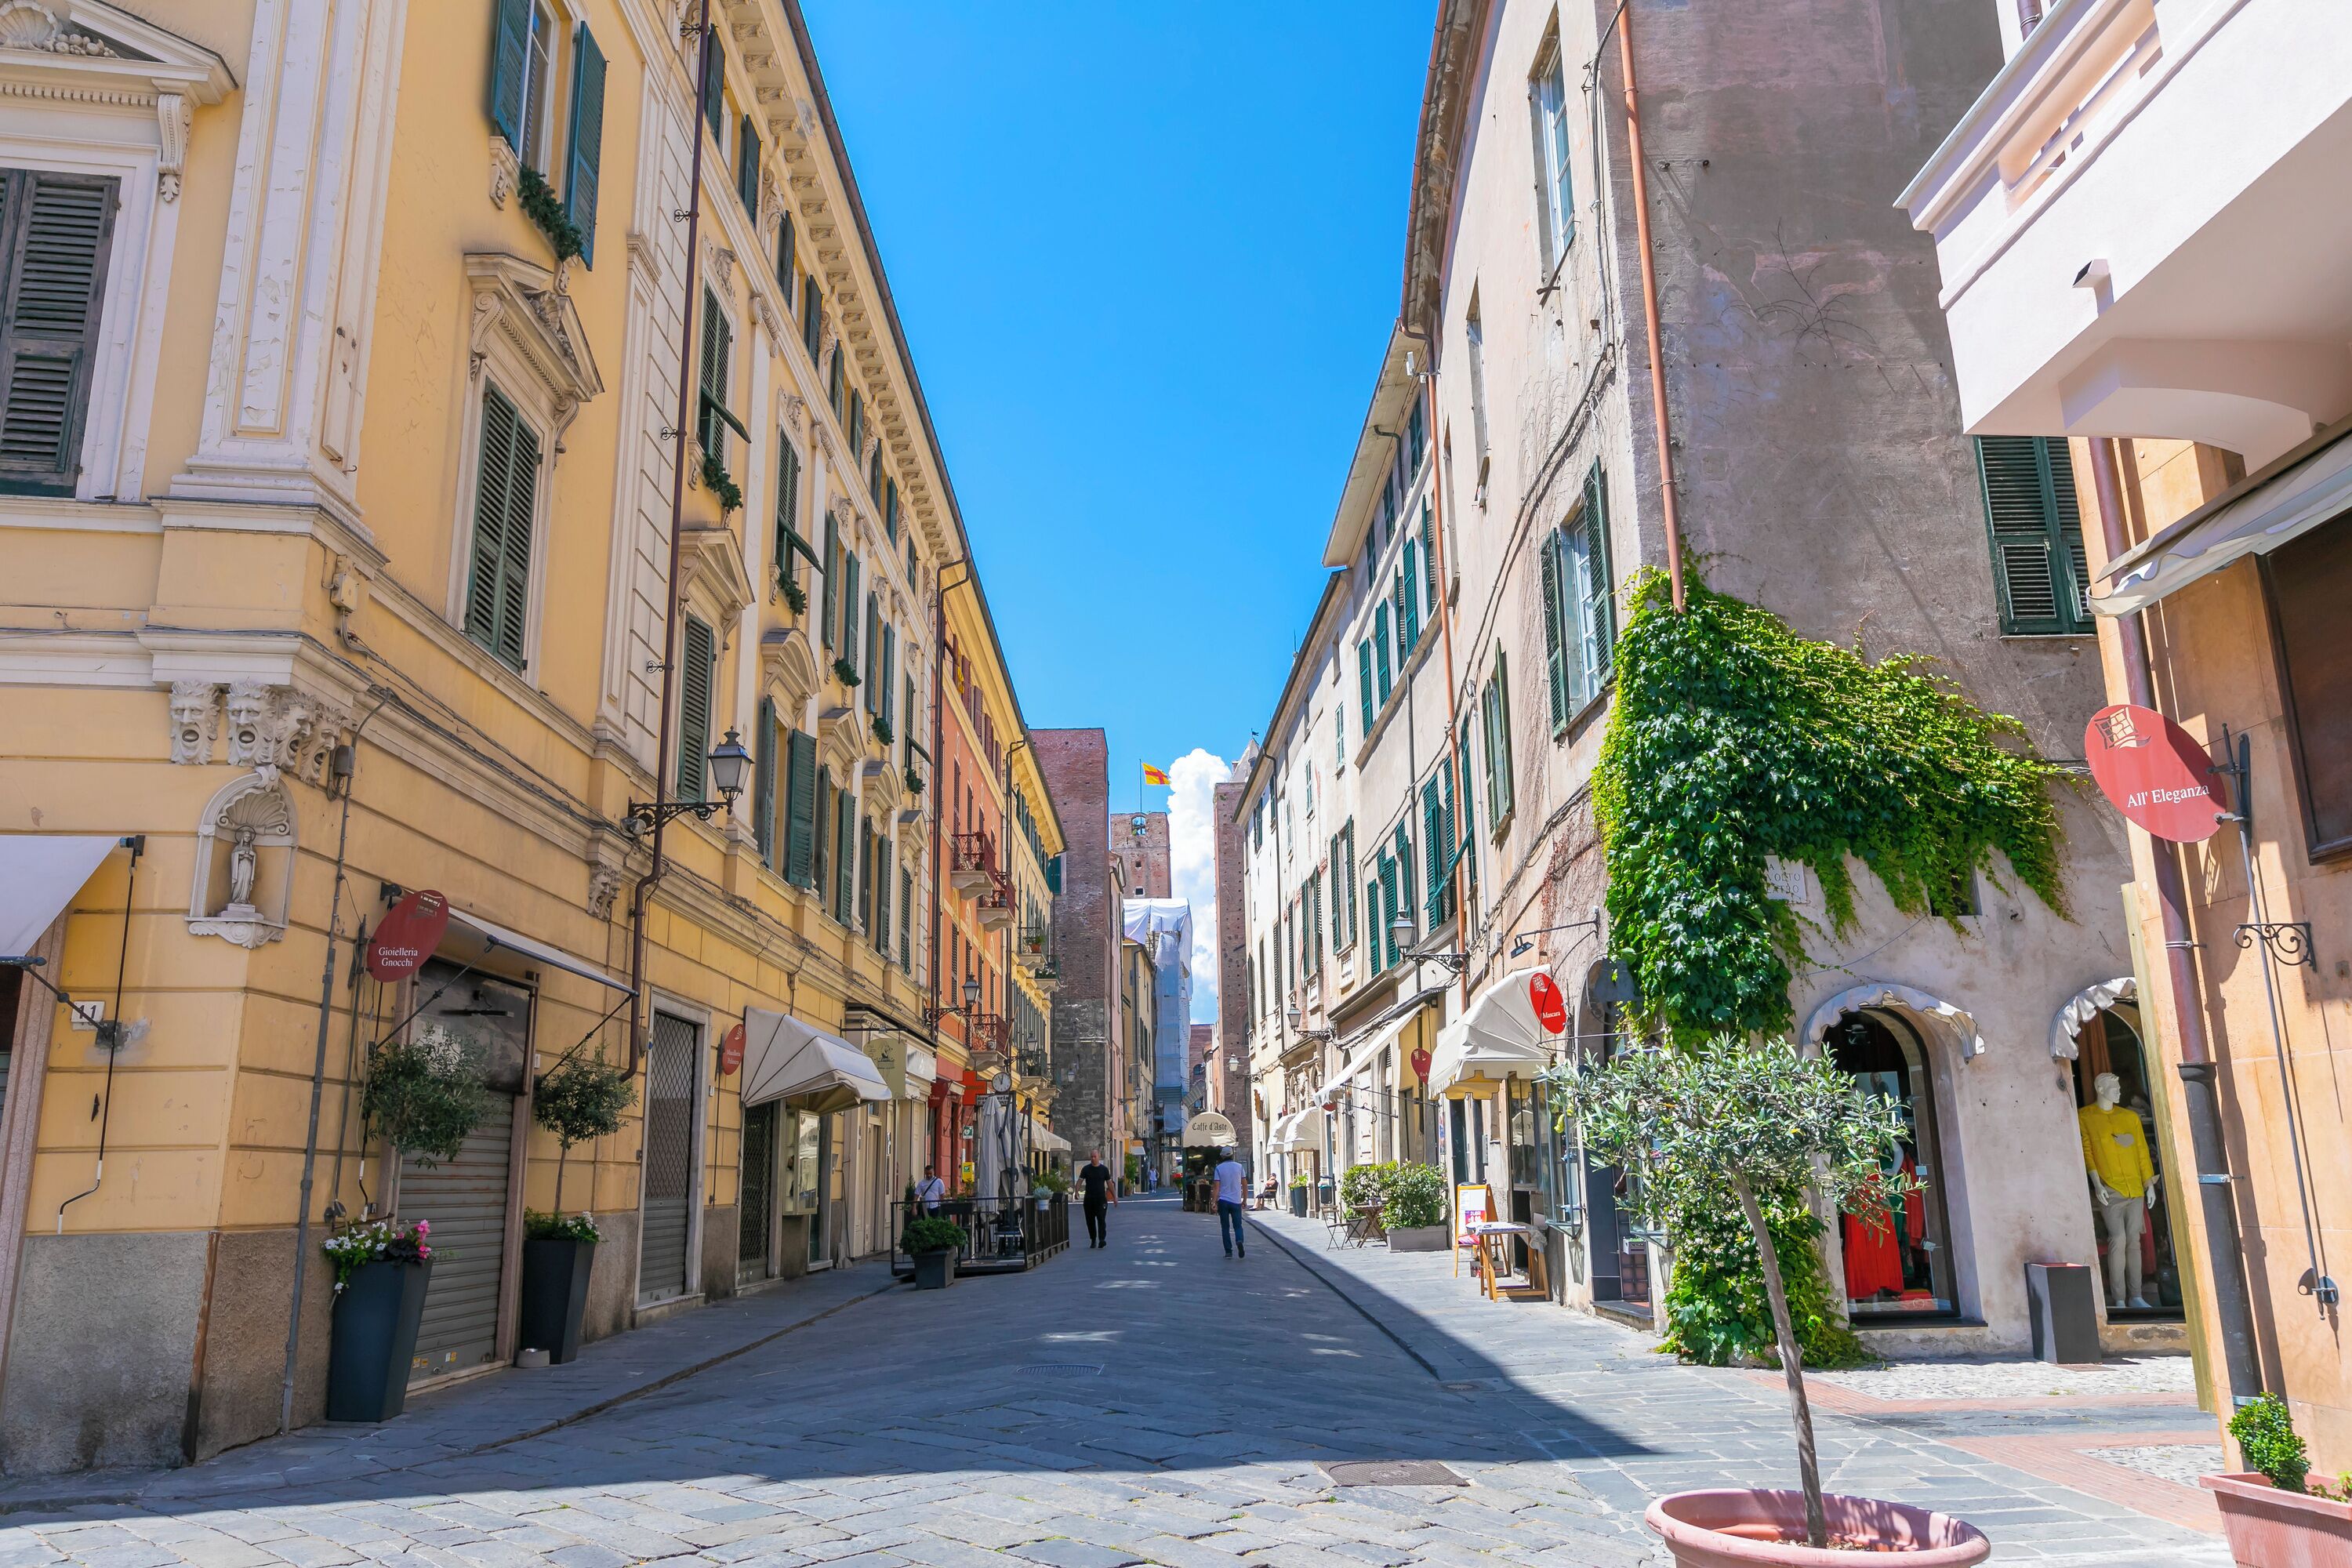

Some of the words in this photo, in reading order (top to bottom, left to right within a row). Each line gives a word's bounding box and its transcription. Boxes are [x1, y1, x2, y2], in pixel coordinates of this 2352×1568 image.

[2127, 791, 2148, 808] All'
[2151, 785, 2210, 804] Eleganza
[378, 946, 418, 956] Gioielleria
[381, 957, 413, 967] Gnocchi
[1542, 1011, 1561, 1019] Mascara
[1209, 1122, 1227, 1131] d'Aste
